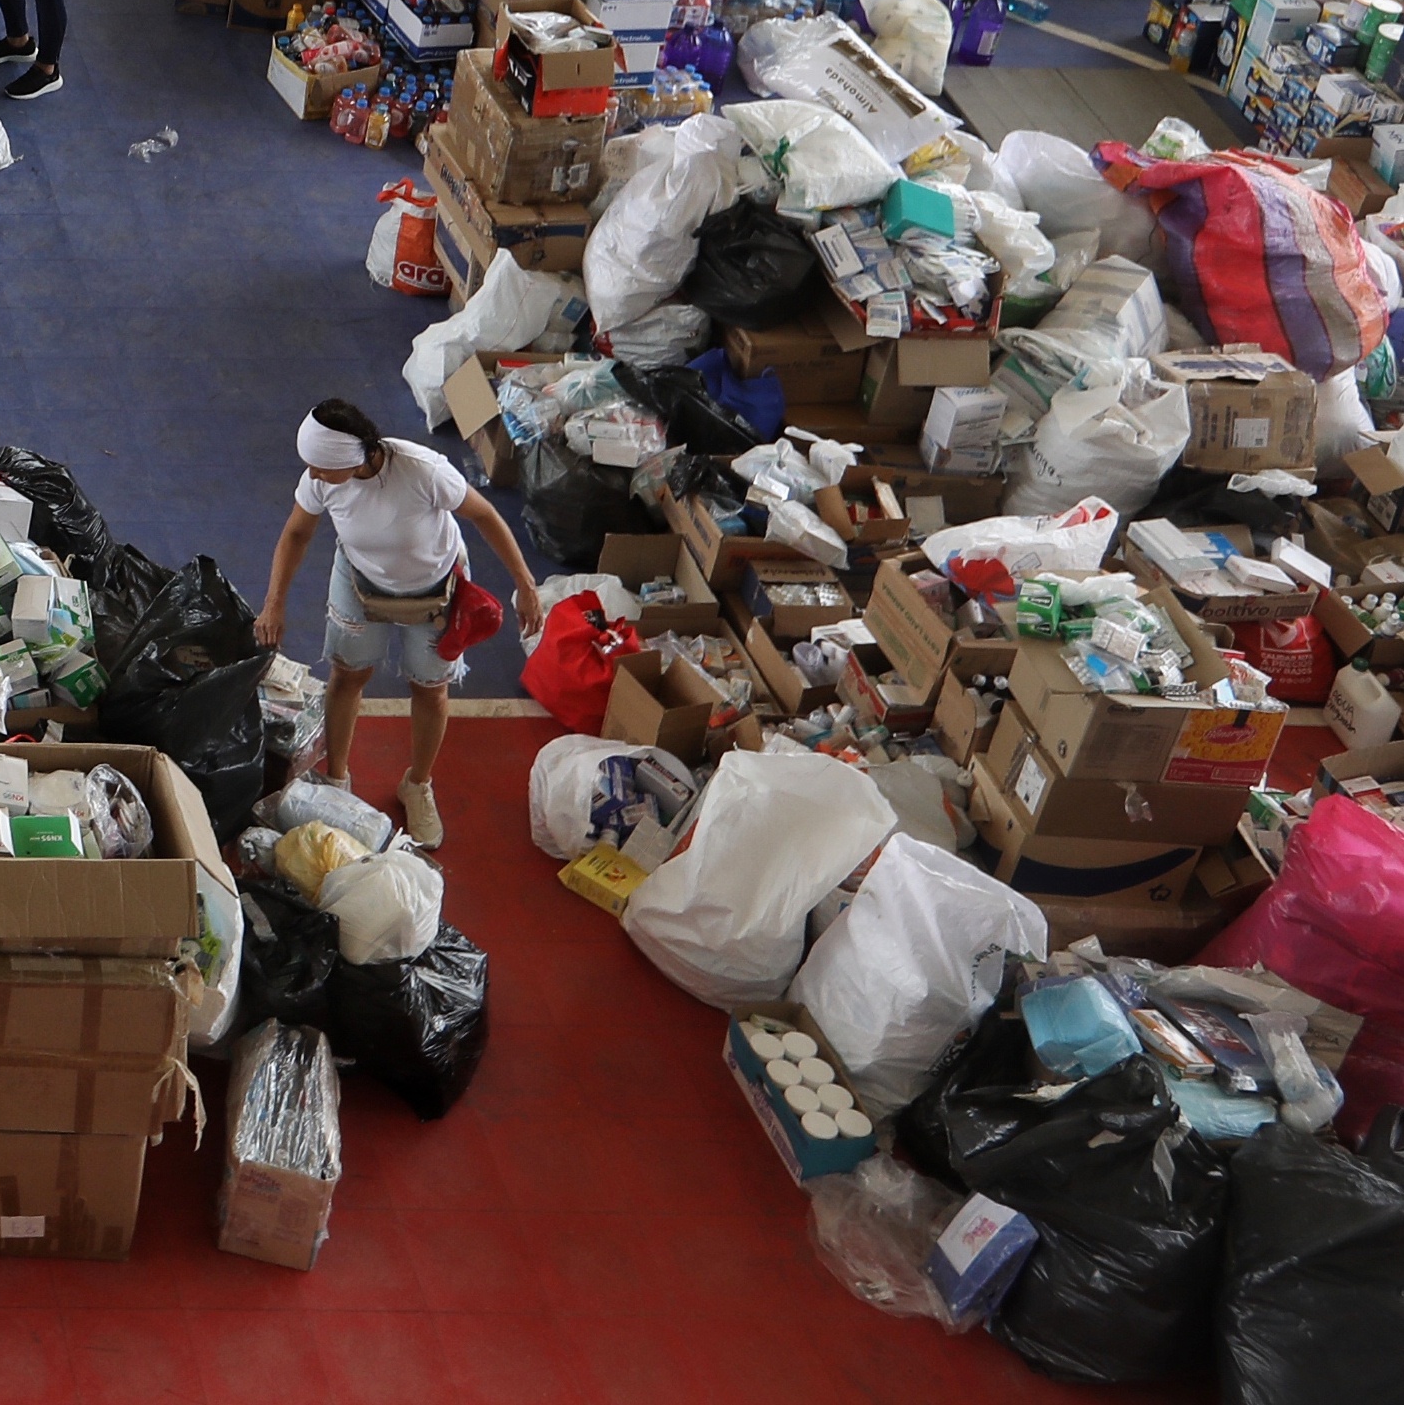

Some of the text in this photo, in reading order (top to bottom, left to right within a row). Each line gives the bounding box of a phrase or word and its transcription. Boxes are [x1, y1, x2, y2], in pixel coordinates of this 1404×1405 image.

[825, 66, 879, 114] Almohada
[398, 262, 445, 286] ara
[2, 791, 25, 802] KN95
[41, 835, 64, 843] KN95
